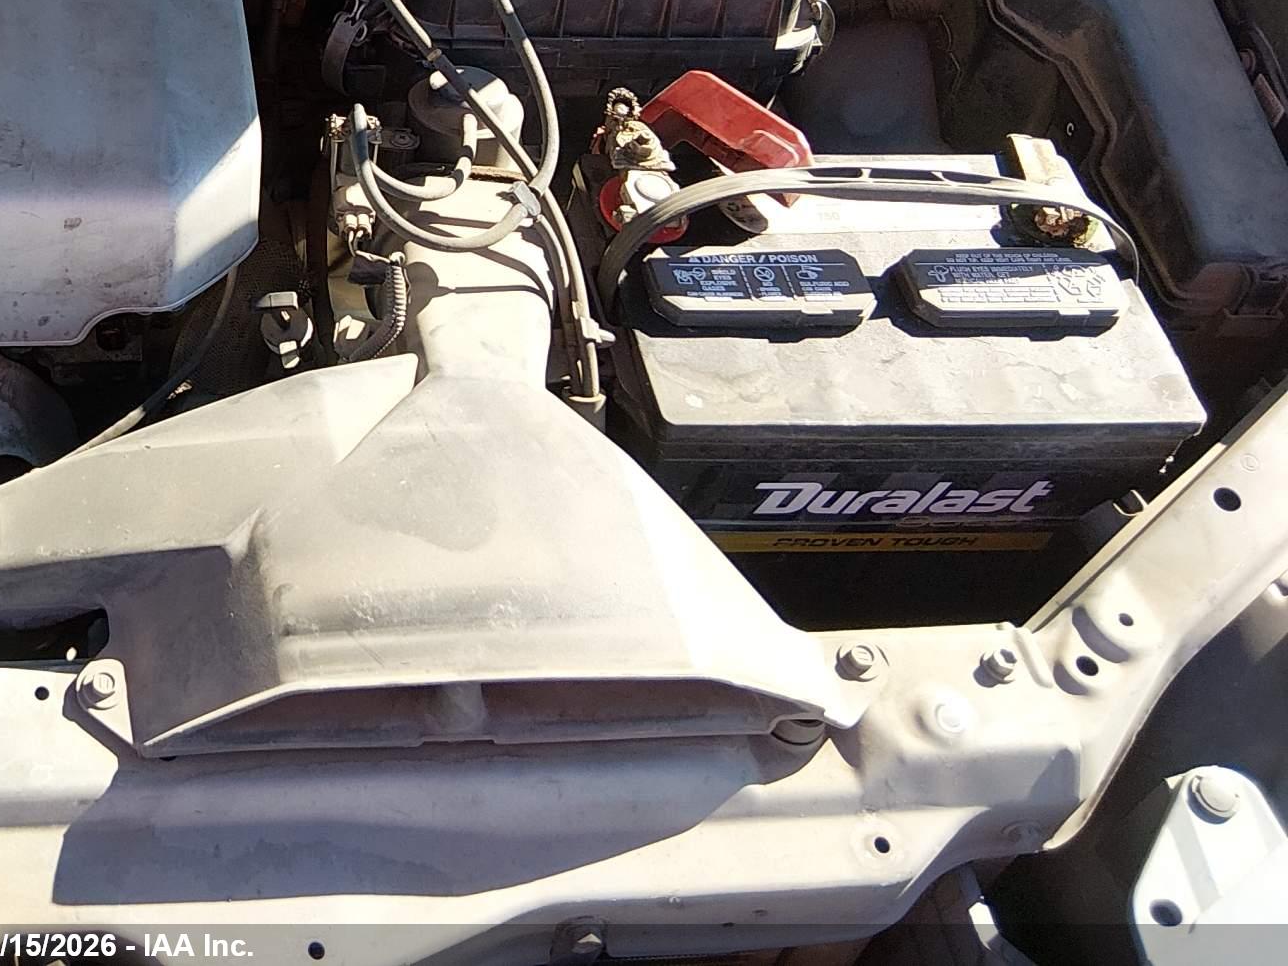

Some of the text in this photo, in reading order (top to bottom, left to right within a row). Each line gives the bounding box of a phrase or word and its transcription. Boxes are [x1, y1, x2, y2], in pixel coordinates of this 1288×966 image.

[700, 254, 818, 264] DANGER / POISON
[753, 480, 1052, 515] Duralast
[772, 536, 979, 547] PROVEN TOUGH
